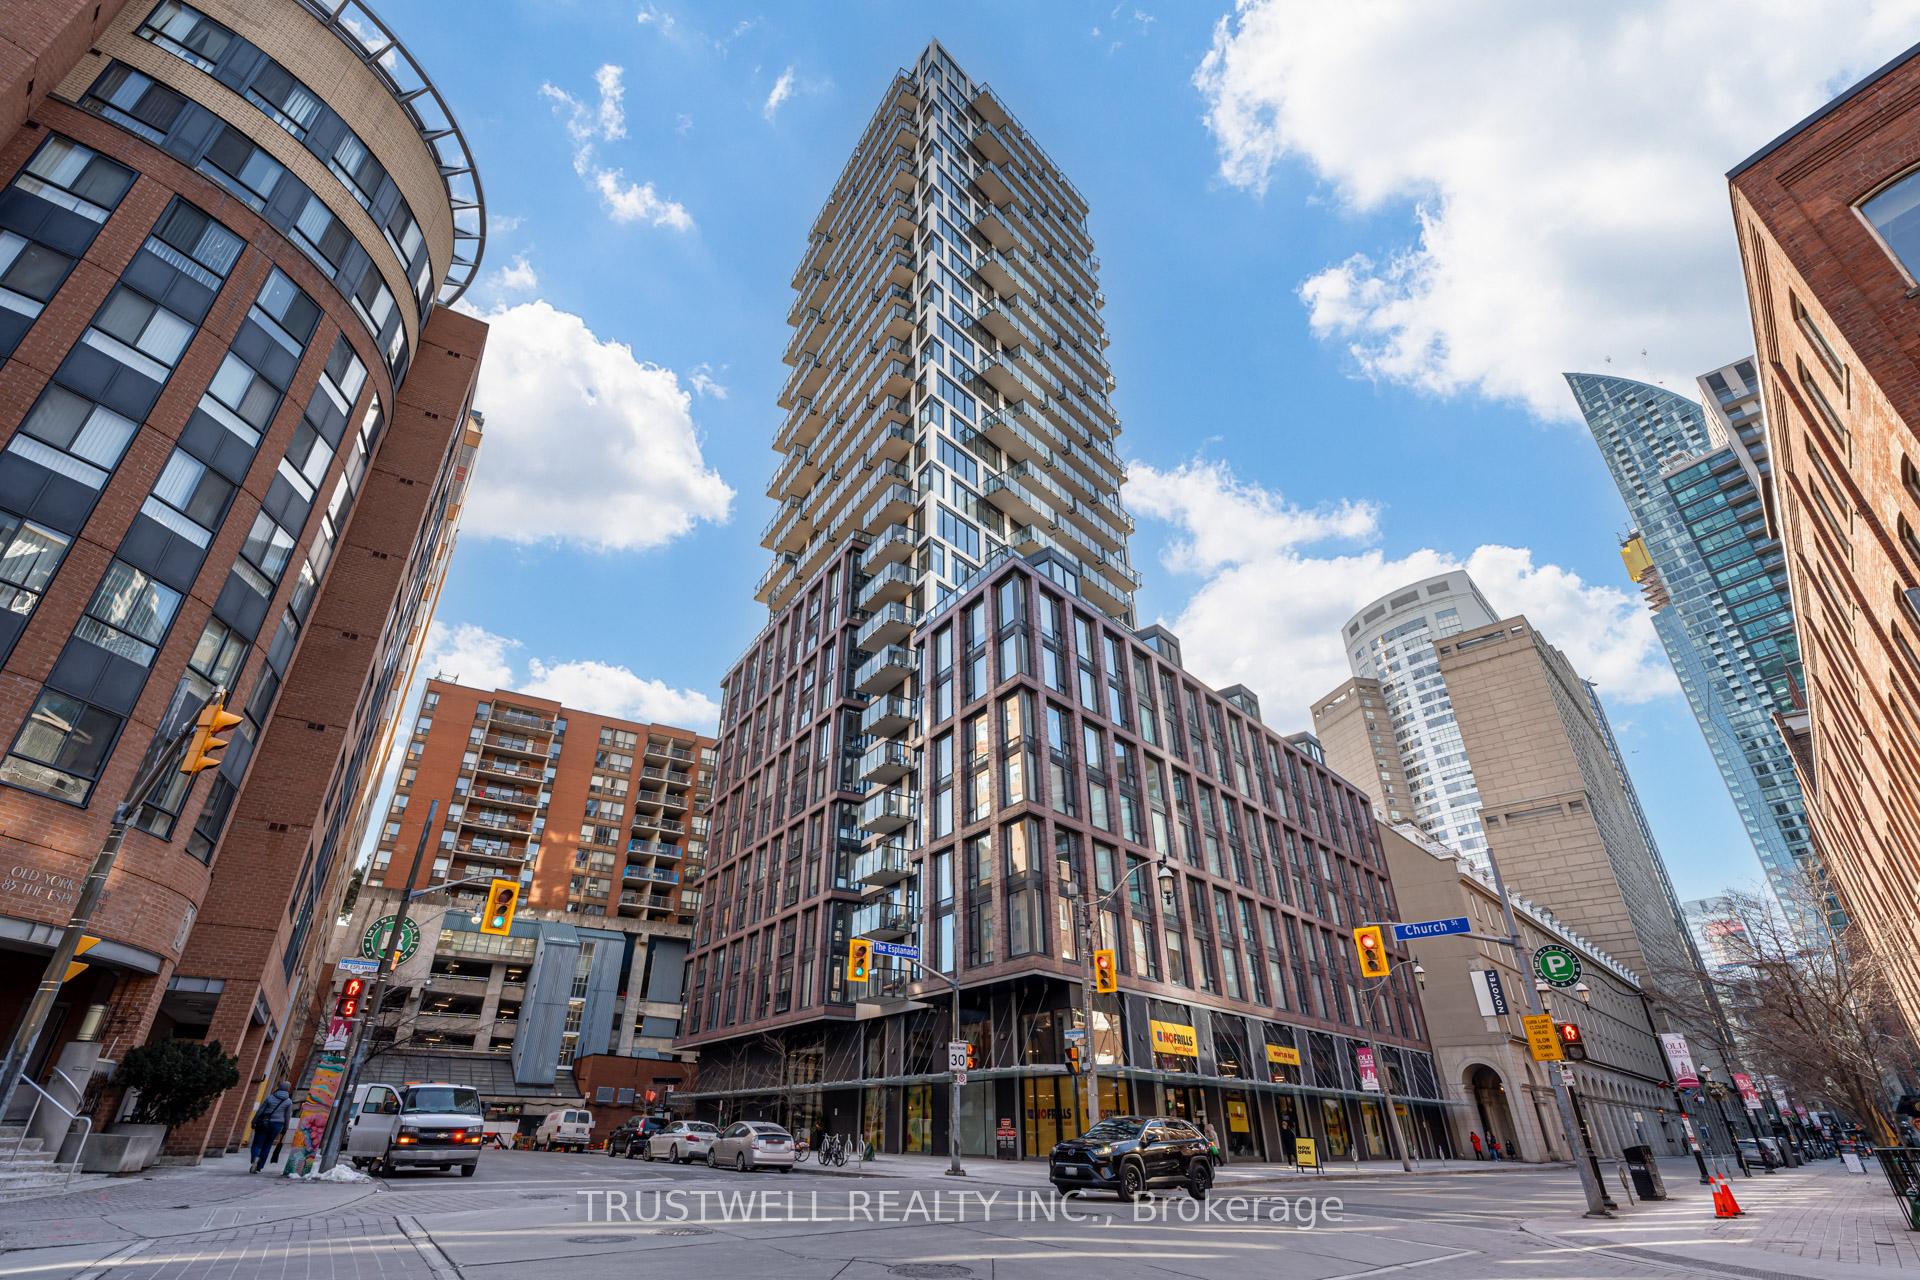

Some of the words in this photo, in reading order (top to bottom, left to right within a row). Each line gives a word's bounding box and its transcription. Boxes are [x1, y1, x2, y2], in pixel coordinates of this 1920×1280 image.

[11, 866, 40, 881] OLD
[45, 873, 73, 890] YORK
[22, 882, 44, 897] THE
[1405, 922, 1447, 935] Church
[875, 942, 887, 952] The
[888, 945, 918, 957] Esplanade
[1534, 946, 1578, 968] MUNICIPAL
[1546, 956, 1566, 973] P
[1488, 972, 1505, 1013] NOVOTEL
[346, 1001, 355, 1015] 5
[1665, 1042, 1686, 1050] OLD
[951, 1054, 965, 1067] 30
